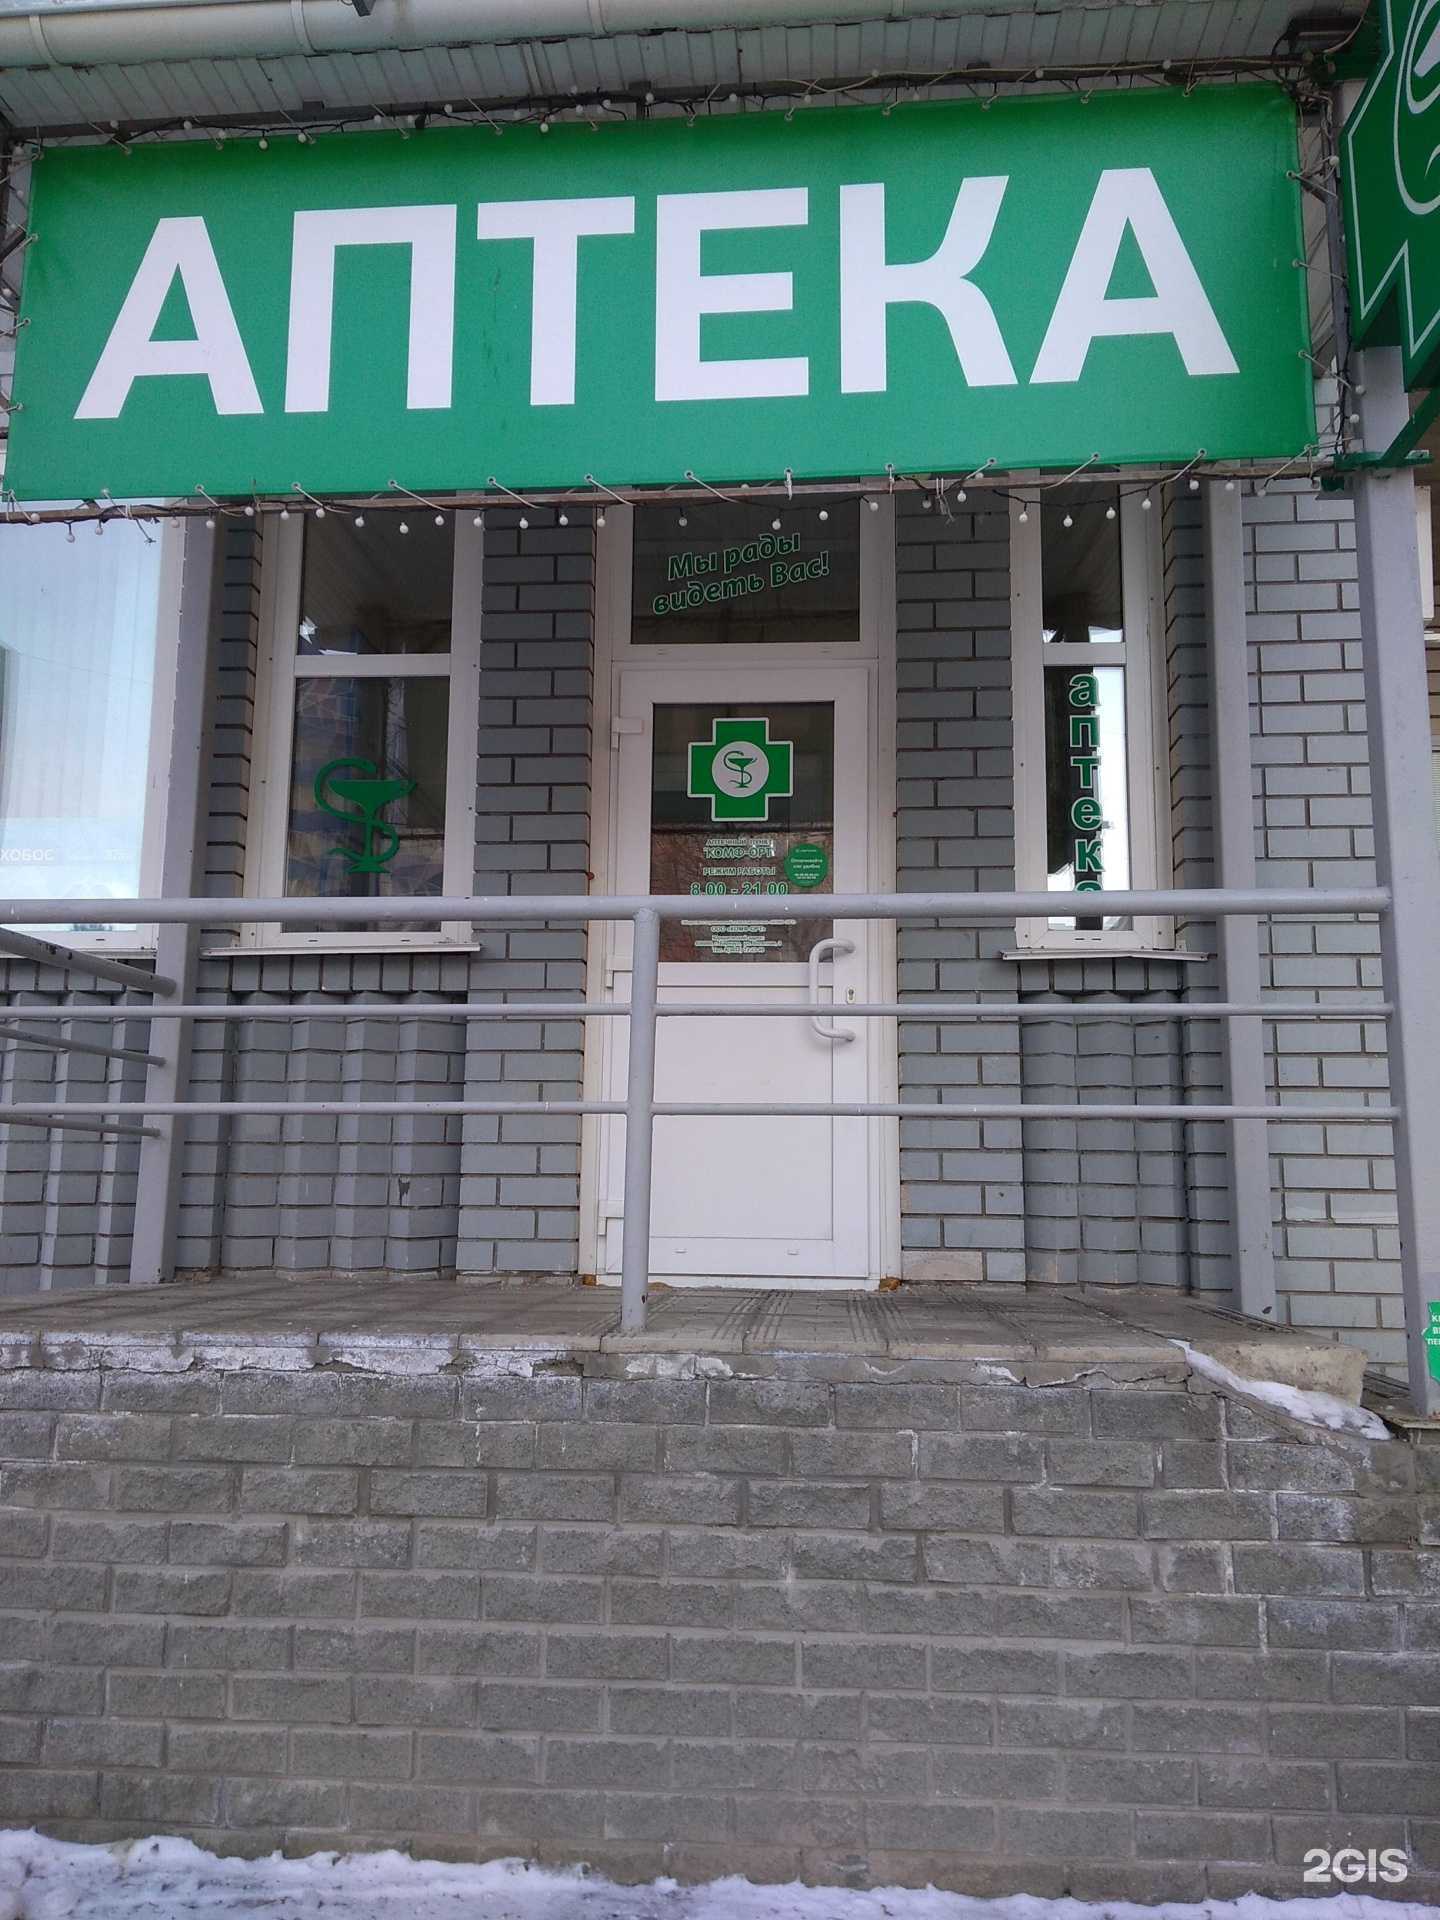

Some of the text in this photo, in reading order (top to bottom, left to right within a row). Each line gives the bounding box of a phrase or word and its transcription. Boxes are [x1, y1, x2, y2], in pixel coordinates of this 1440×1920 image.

[73, 167, 1241, 421] АПТЕКА
[652, 551, 830, 615] видеть Вас!
[668, 532, 801, 581] Мы рады
[1068, 672, 1105, 893] аптек
[703, 867, 776, 876] РЕЖИМ РАБОТЫ
